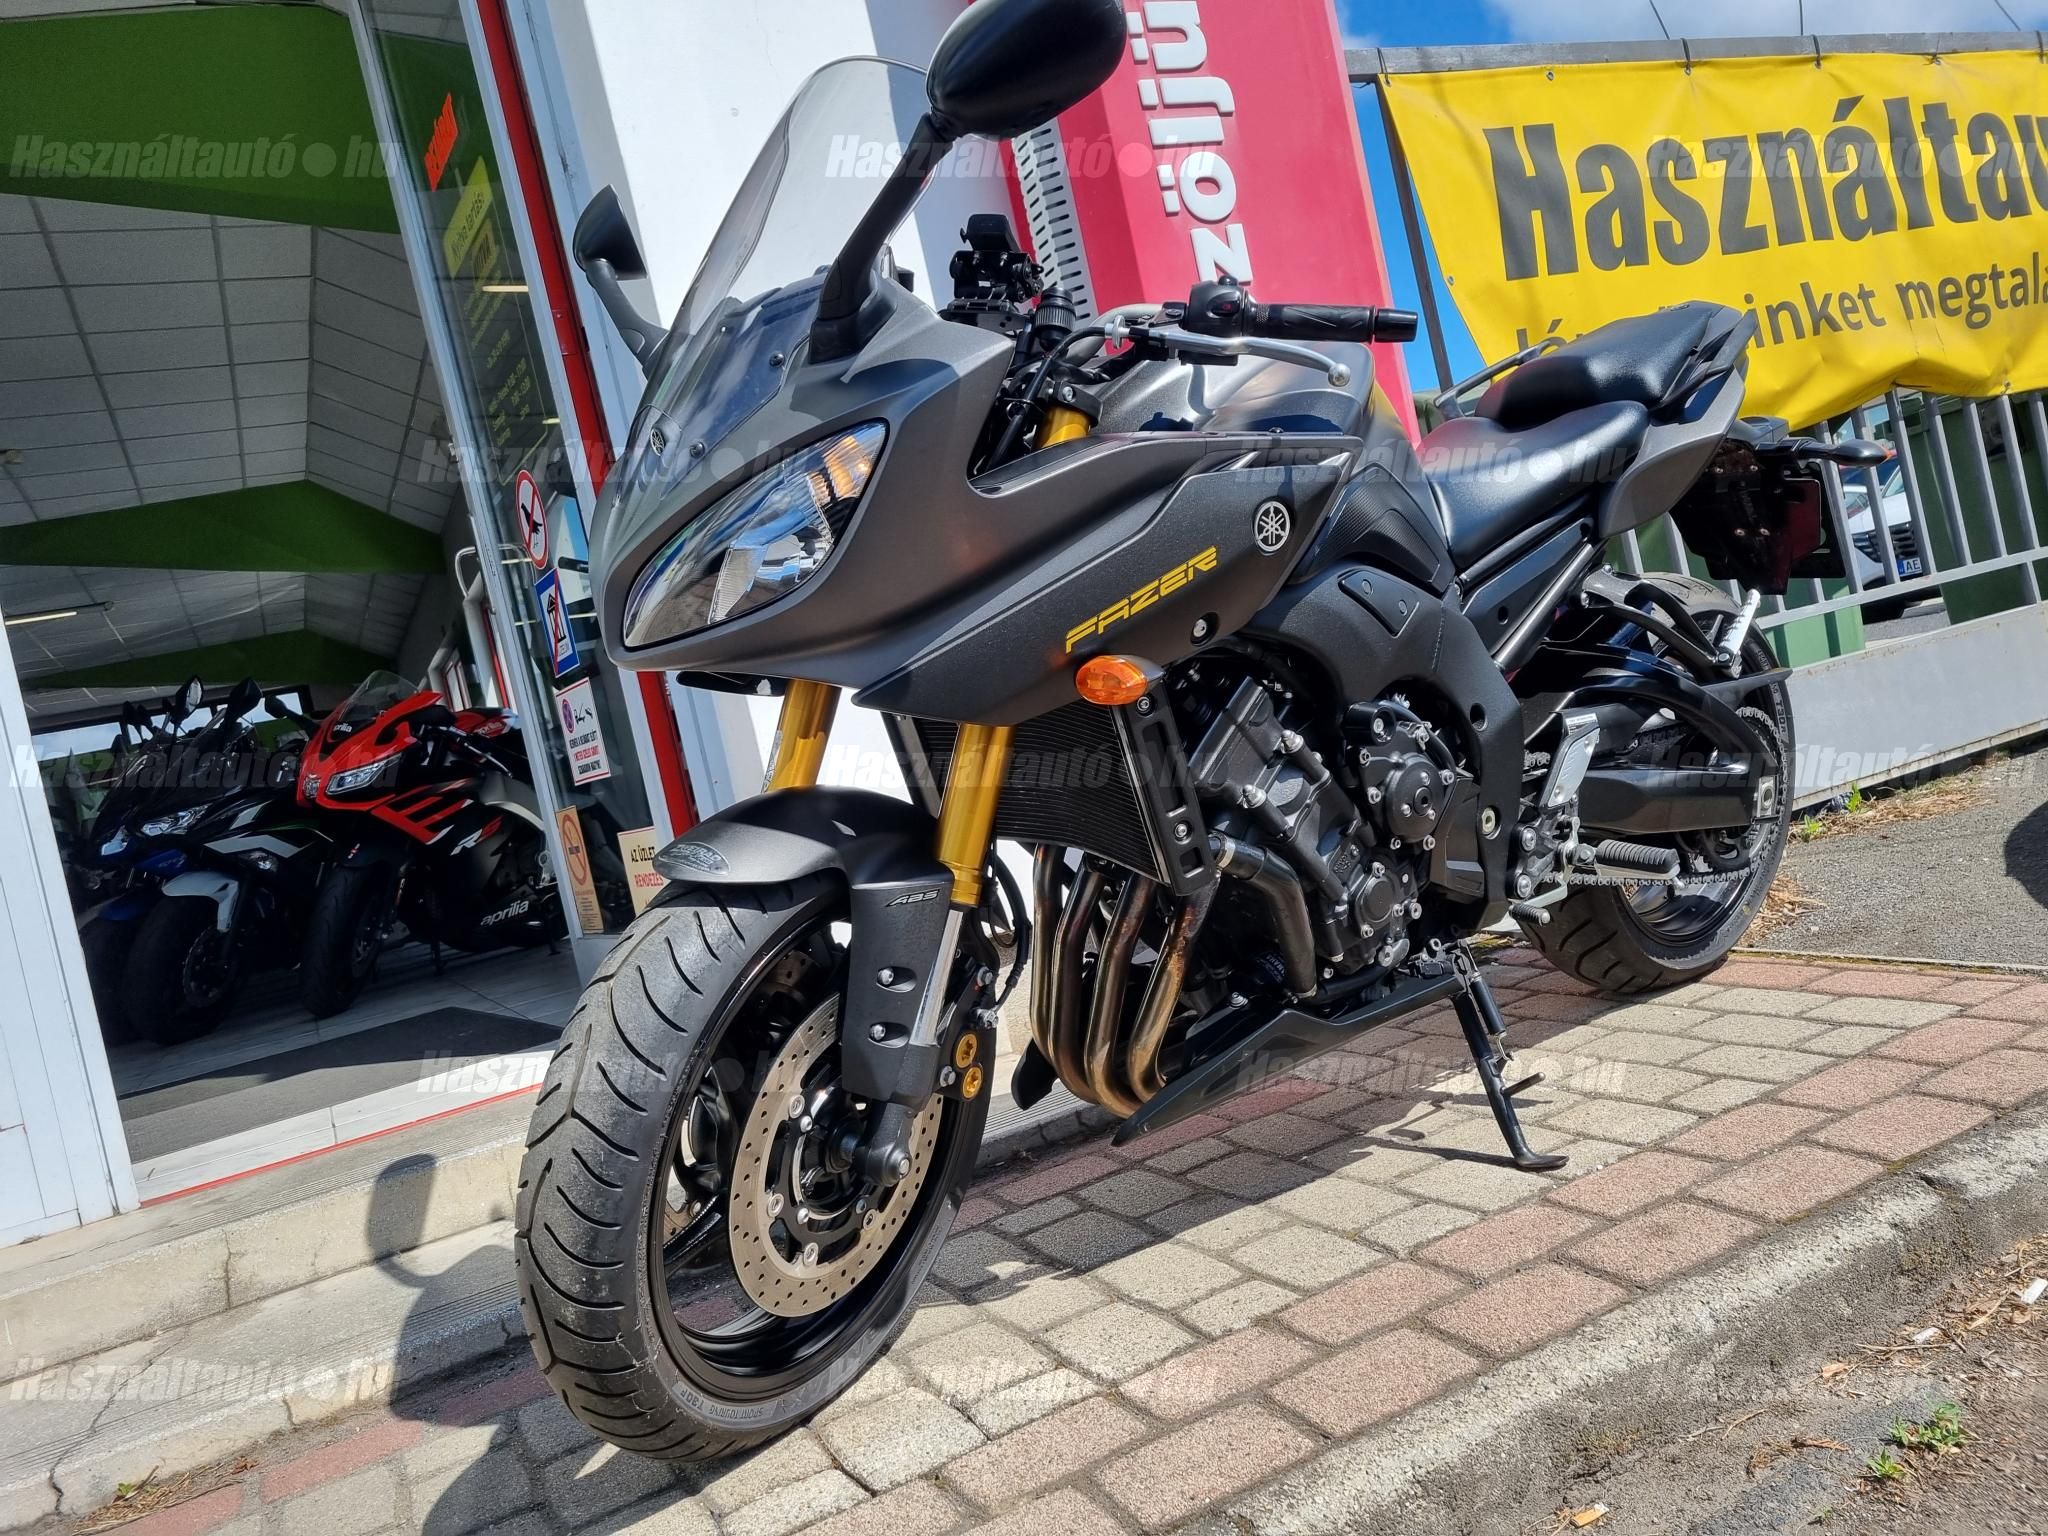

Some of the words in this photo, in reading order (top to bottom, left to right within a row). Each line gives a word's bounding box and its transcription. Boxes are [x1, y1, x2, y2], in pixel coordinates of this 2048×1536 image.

[1065, 545, 1217, 654] FAZER
[886, 889, 940, 907] ABS
[480, 900, 529, 925] aprilia
